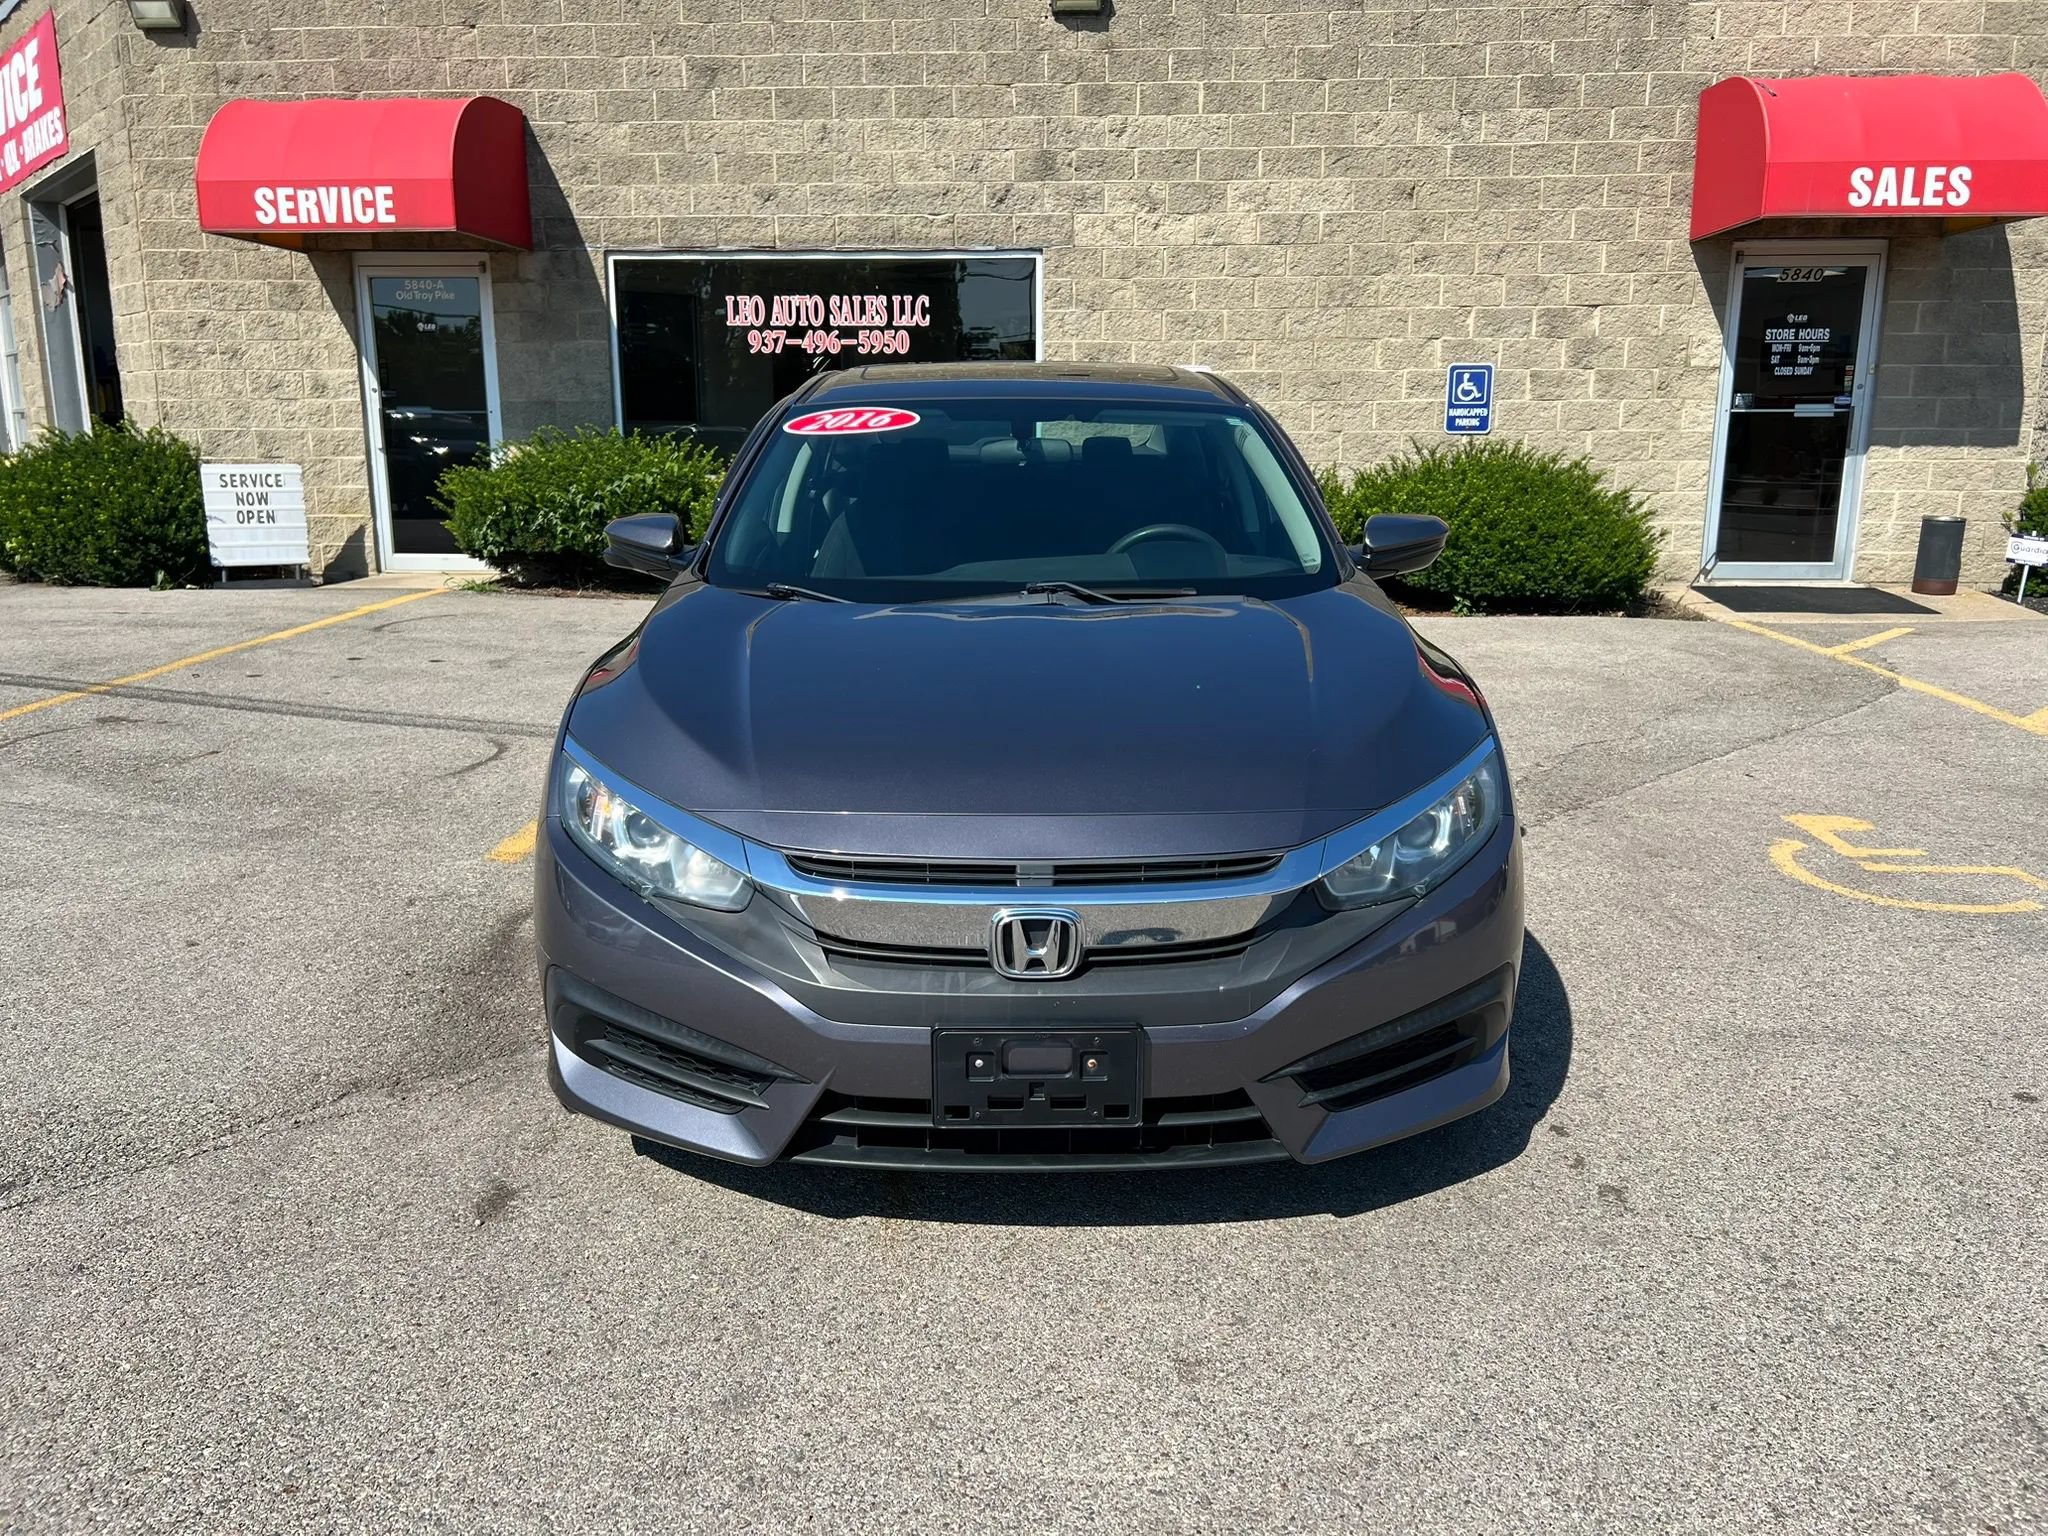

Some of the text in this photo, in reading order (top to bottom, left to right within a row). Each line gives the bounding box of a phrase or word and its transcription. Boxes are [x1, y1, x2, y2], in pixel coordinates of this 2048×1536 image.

[1848, 165, 1972, 208] SALES
[254, 185, 396, 225] SERVICE
[1781, 268, 1824, 281] 5840
[404, 280, 444, 290] 5840-A
[396, 290, 455, 302] Old Troy Pike
[725, 295, 930, 326] LEO AUTO SALES LLC
[1765, 328, 1830, 340] STORE HOURS
[747, 330, 910, 354] 937-496-5950
[1771, 343, 1792, 353] MON-FRI
[1770, 355, 1780, 364] SAT
[1774, 366, 1813, 375] CLOSED SUNDAY
[1449, 408, 1488, 417] HANDICAPPED
[802, 411, 892, 431] 2016
[1455, 418, 1480, 427] PARKING
[219, 473, 283, 488] SERVICE
[235, 491, 269, 506] NOW
[236, 509, 276, 524] OPEN
